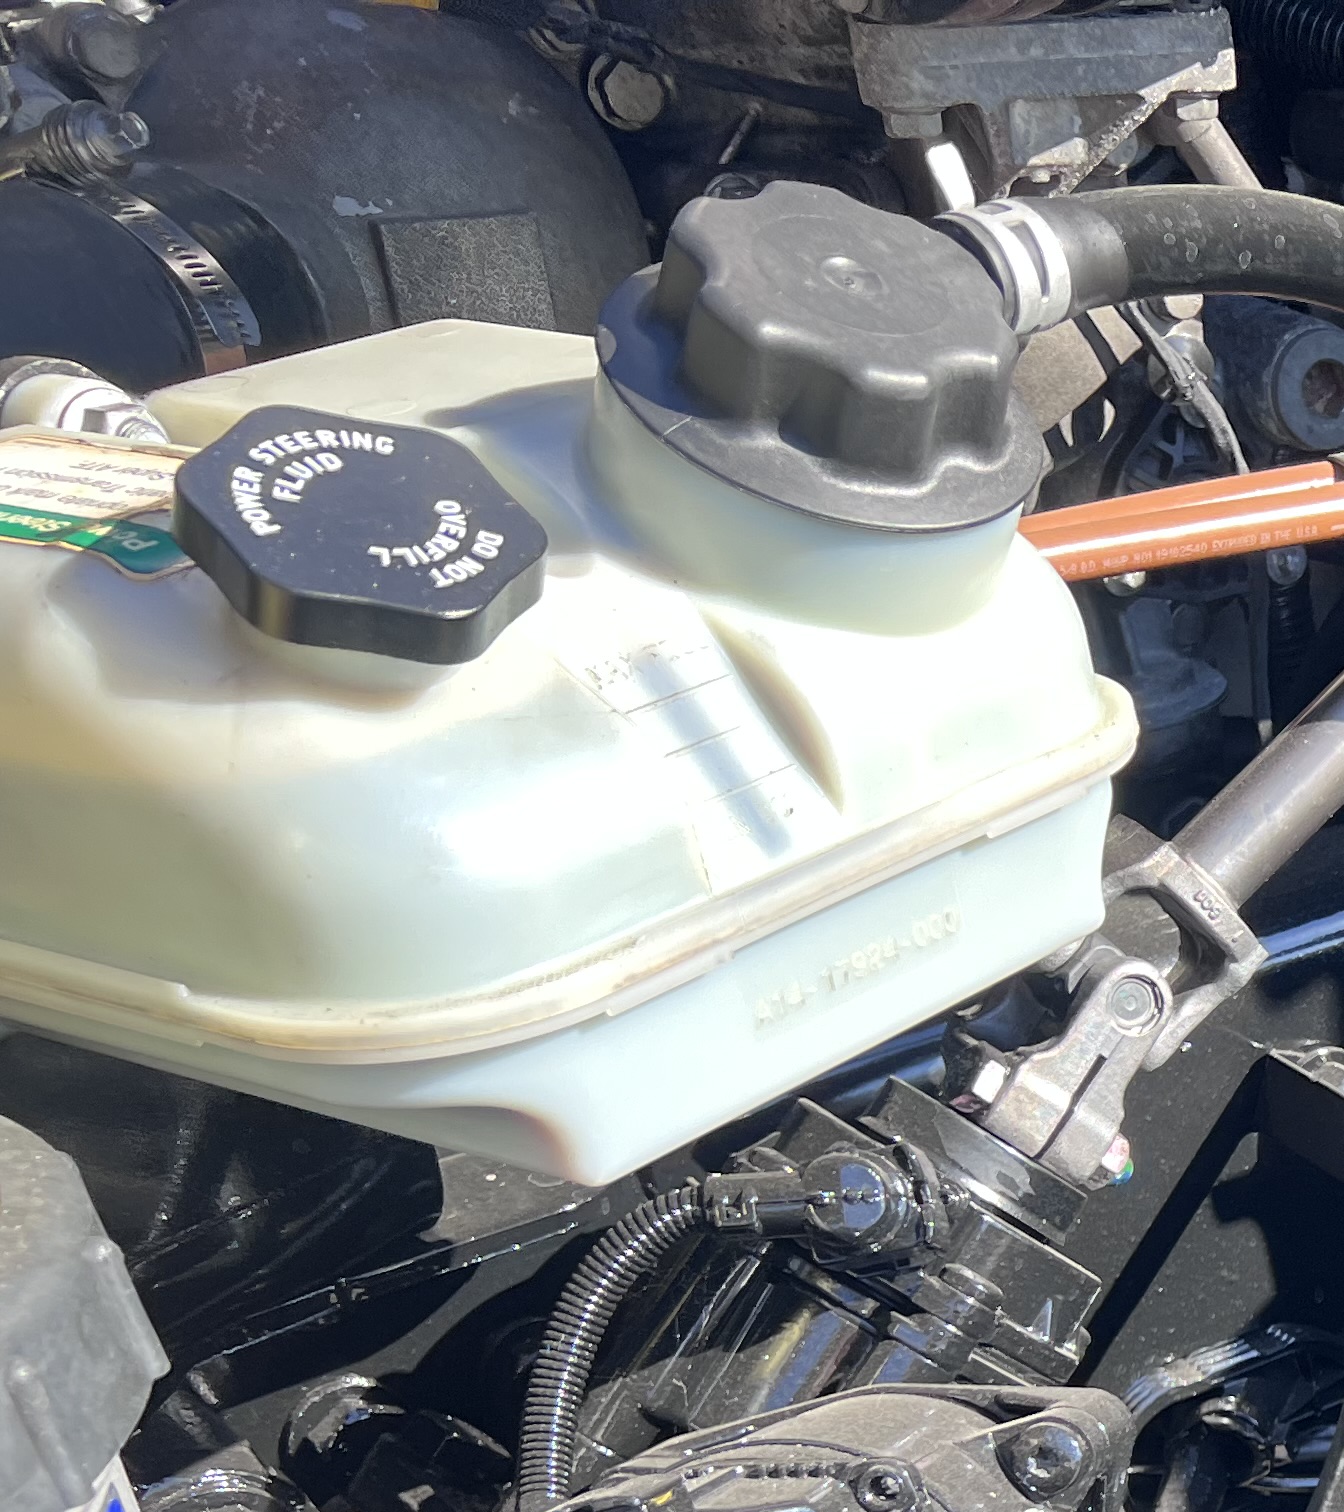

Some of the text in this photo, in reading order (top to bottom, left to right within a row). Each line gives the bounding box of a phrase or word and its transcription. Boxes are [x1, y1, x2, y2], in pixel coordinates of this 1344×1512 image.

[230, 428, 396, 537] POWER STEERING
[272, 451, 344, 504] FLUID
[367, 499, 468, 568] OVERFILL
[428, 528, 505, 589] DO NOT
